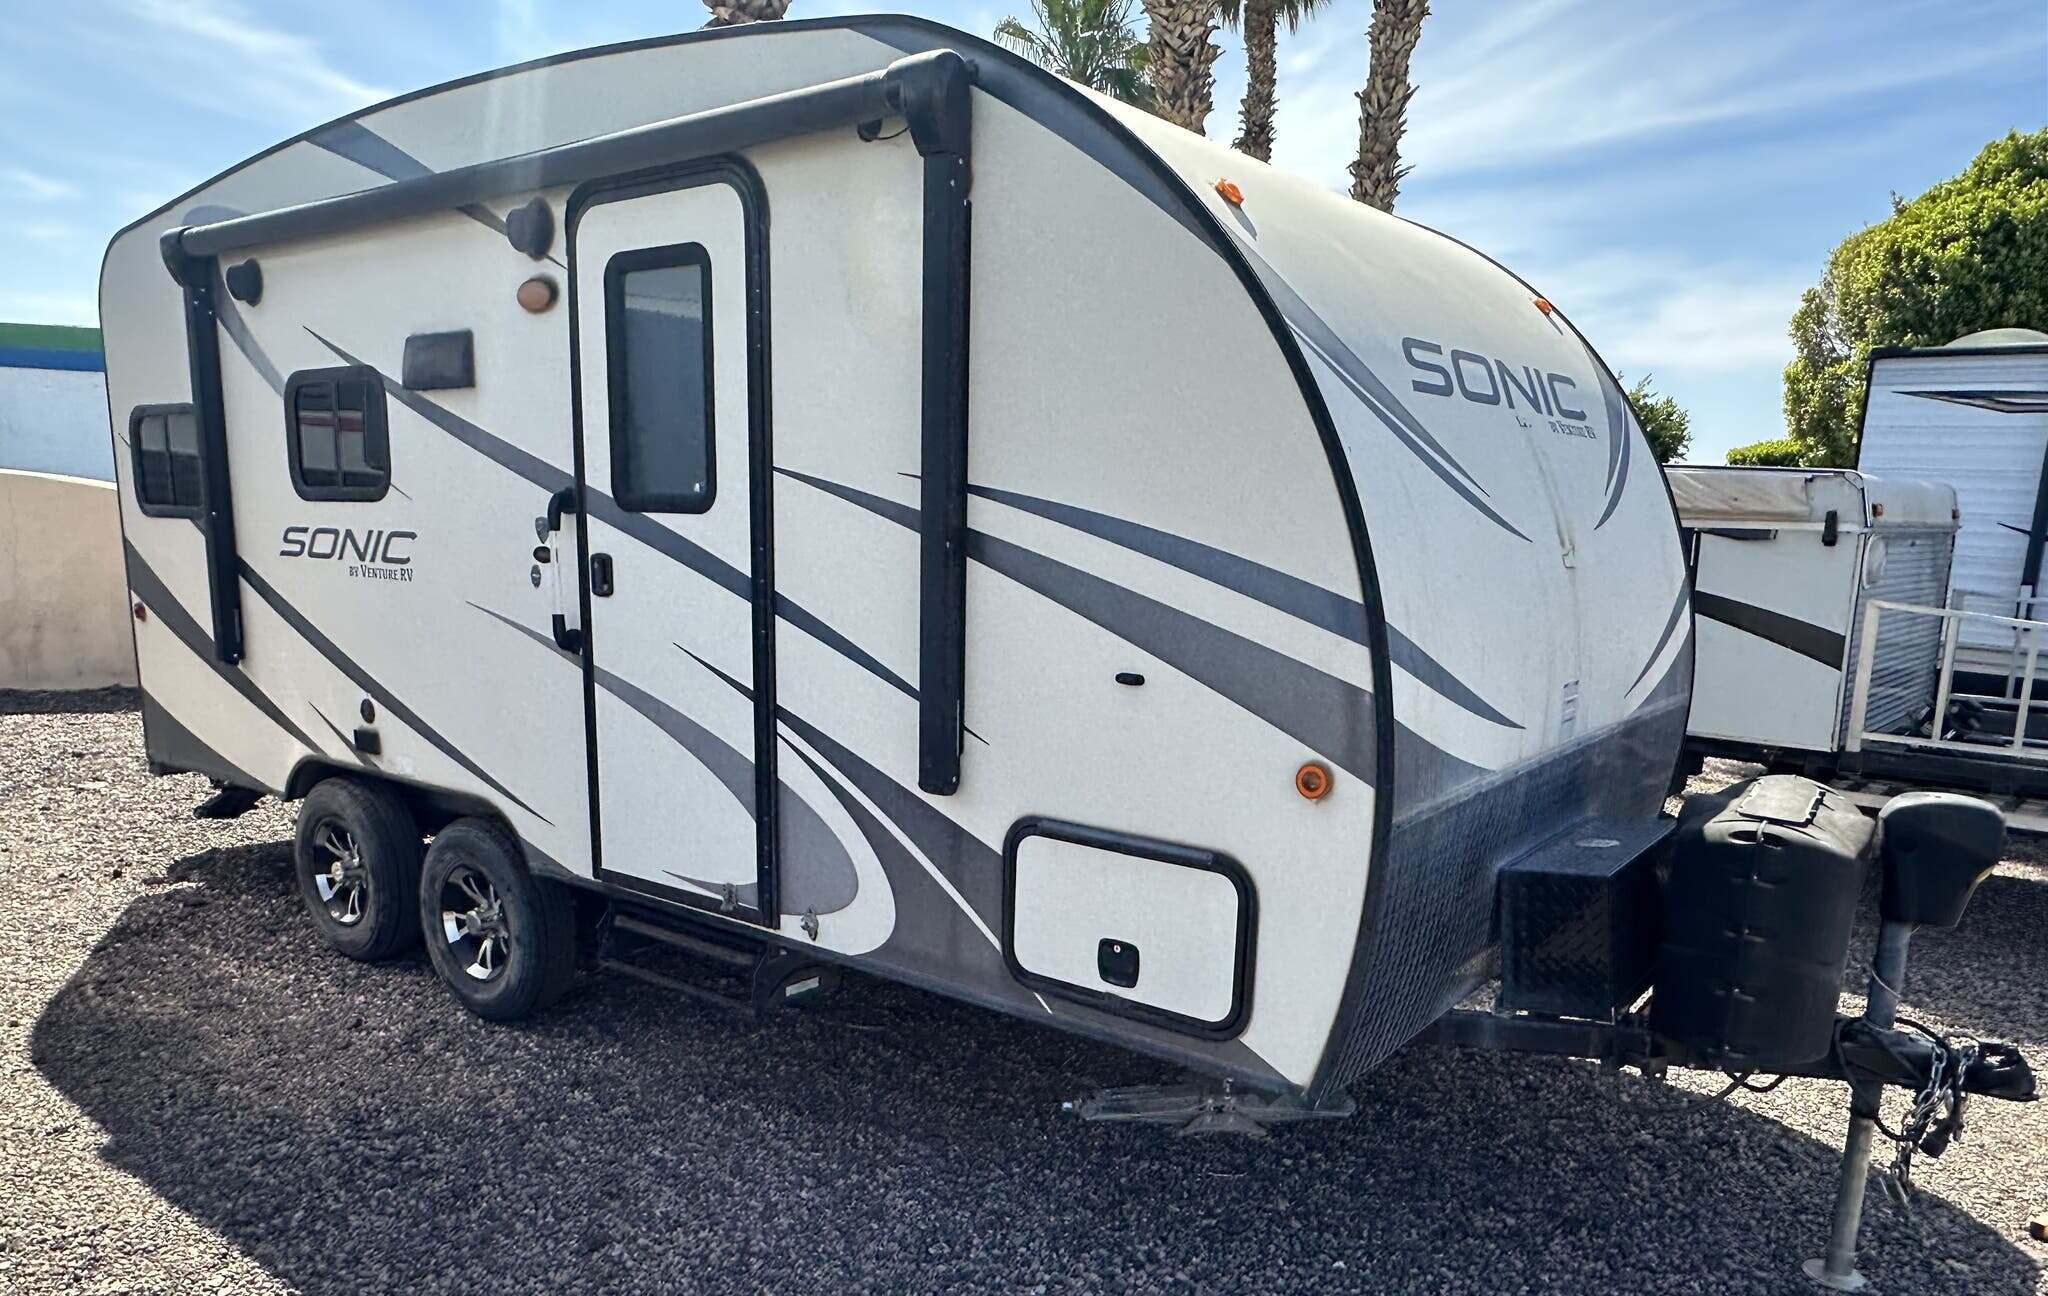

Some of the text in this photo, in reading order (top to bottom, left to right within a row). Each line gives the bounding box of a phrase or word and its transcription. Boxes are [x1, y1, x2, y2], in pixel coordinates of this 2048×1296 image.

[1402, 336, 1588, 422] SONIC
[279, 526, 418, 565] SONIC
[360, 564, 399, 581] VENTURE
[400, 567, 414, 582] RV
